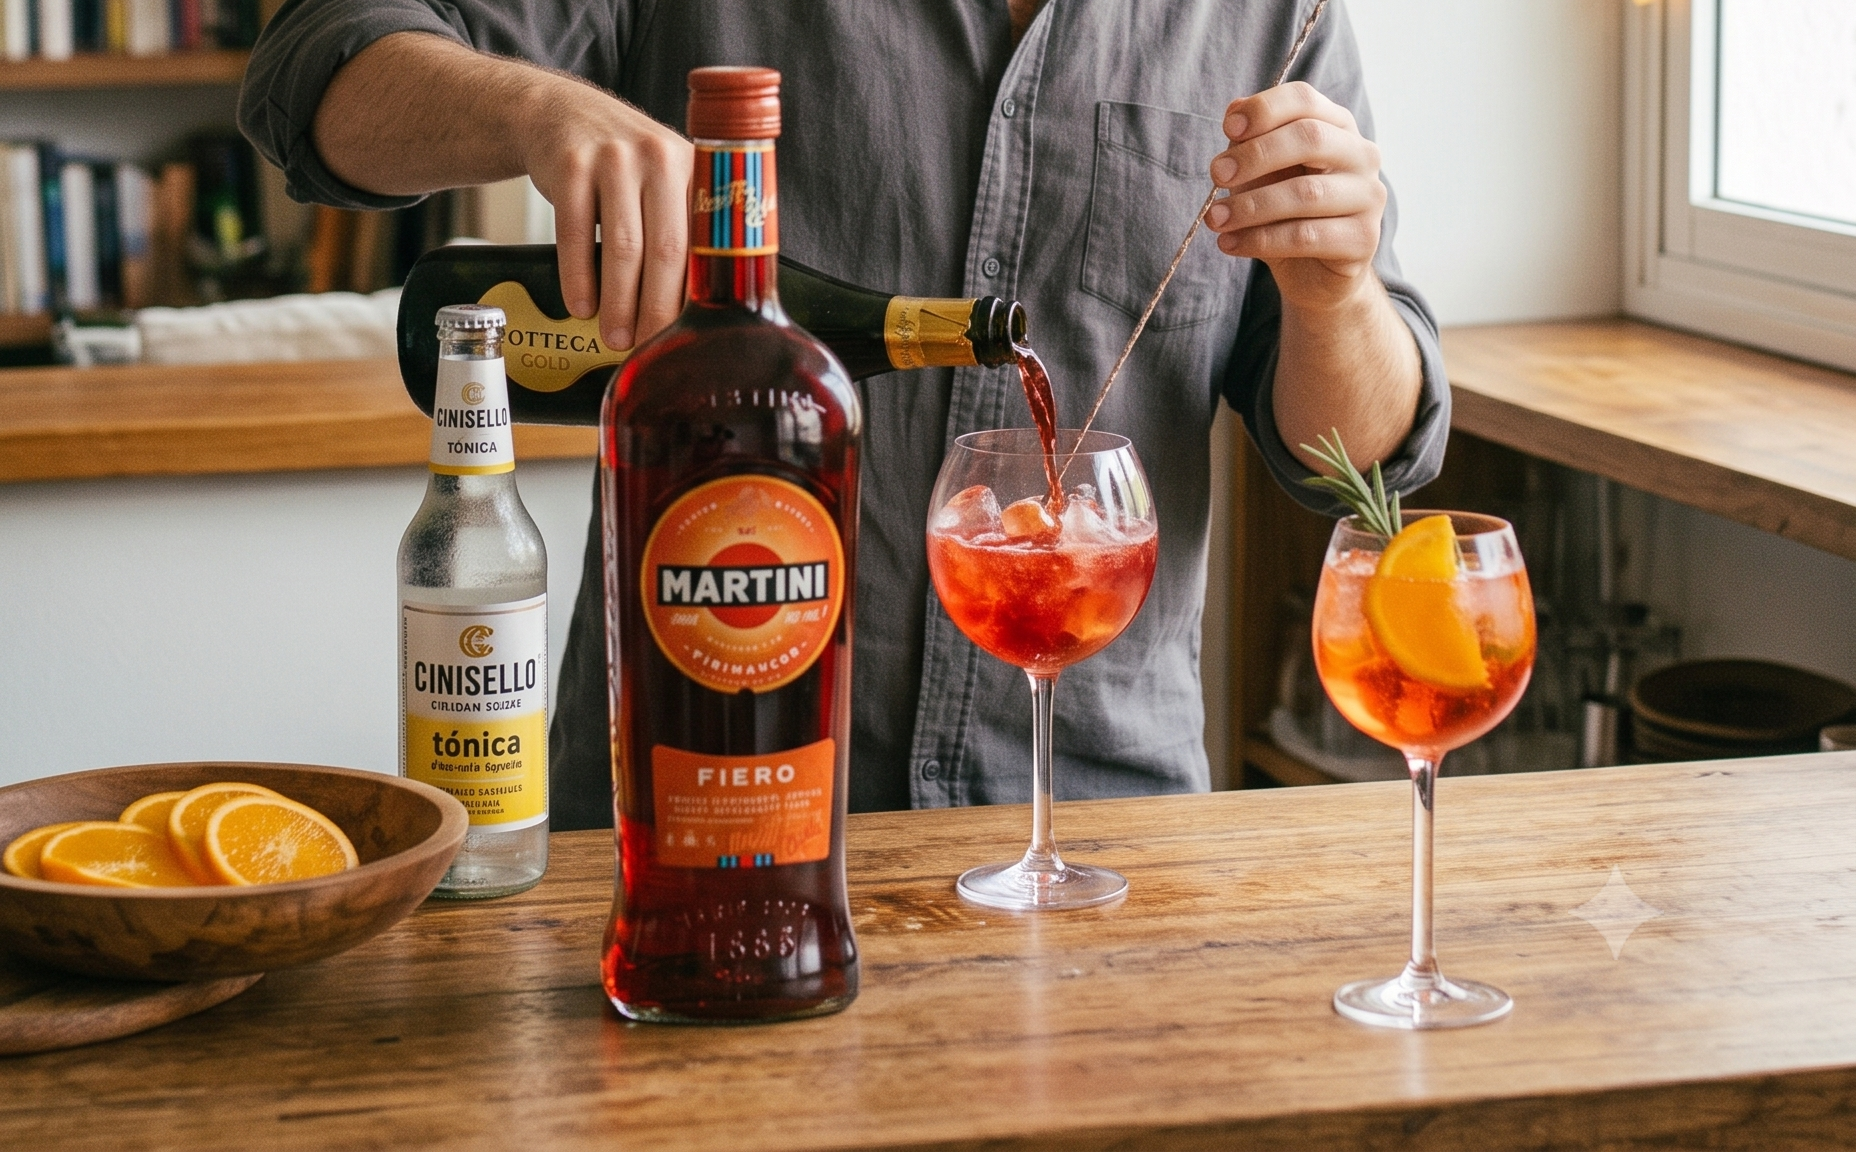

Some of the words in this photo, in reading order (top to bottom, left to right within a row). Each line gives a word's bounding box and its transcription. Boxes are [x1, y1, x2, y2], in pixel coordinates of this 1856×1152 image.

[501, 327, 601, 355] OTTECA
[520, 353, 571, 371] GOLD
[437, 407, 508, 429] CINISELLO
[447, 438, 498, 454] TÓNICA
[662, 563, 826, 604] MARTINI
[414, 658, 536, 696] CINISELLO
[432, 730, 521, 758] tónica
[697, 763, 796, 787] FIERO
